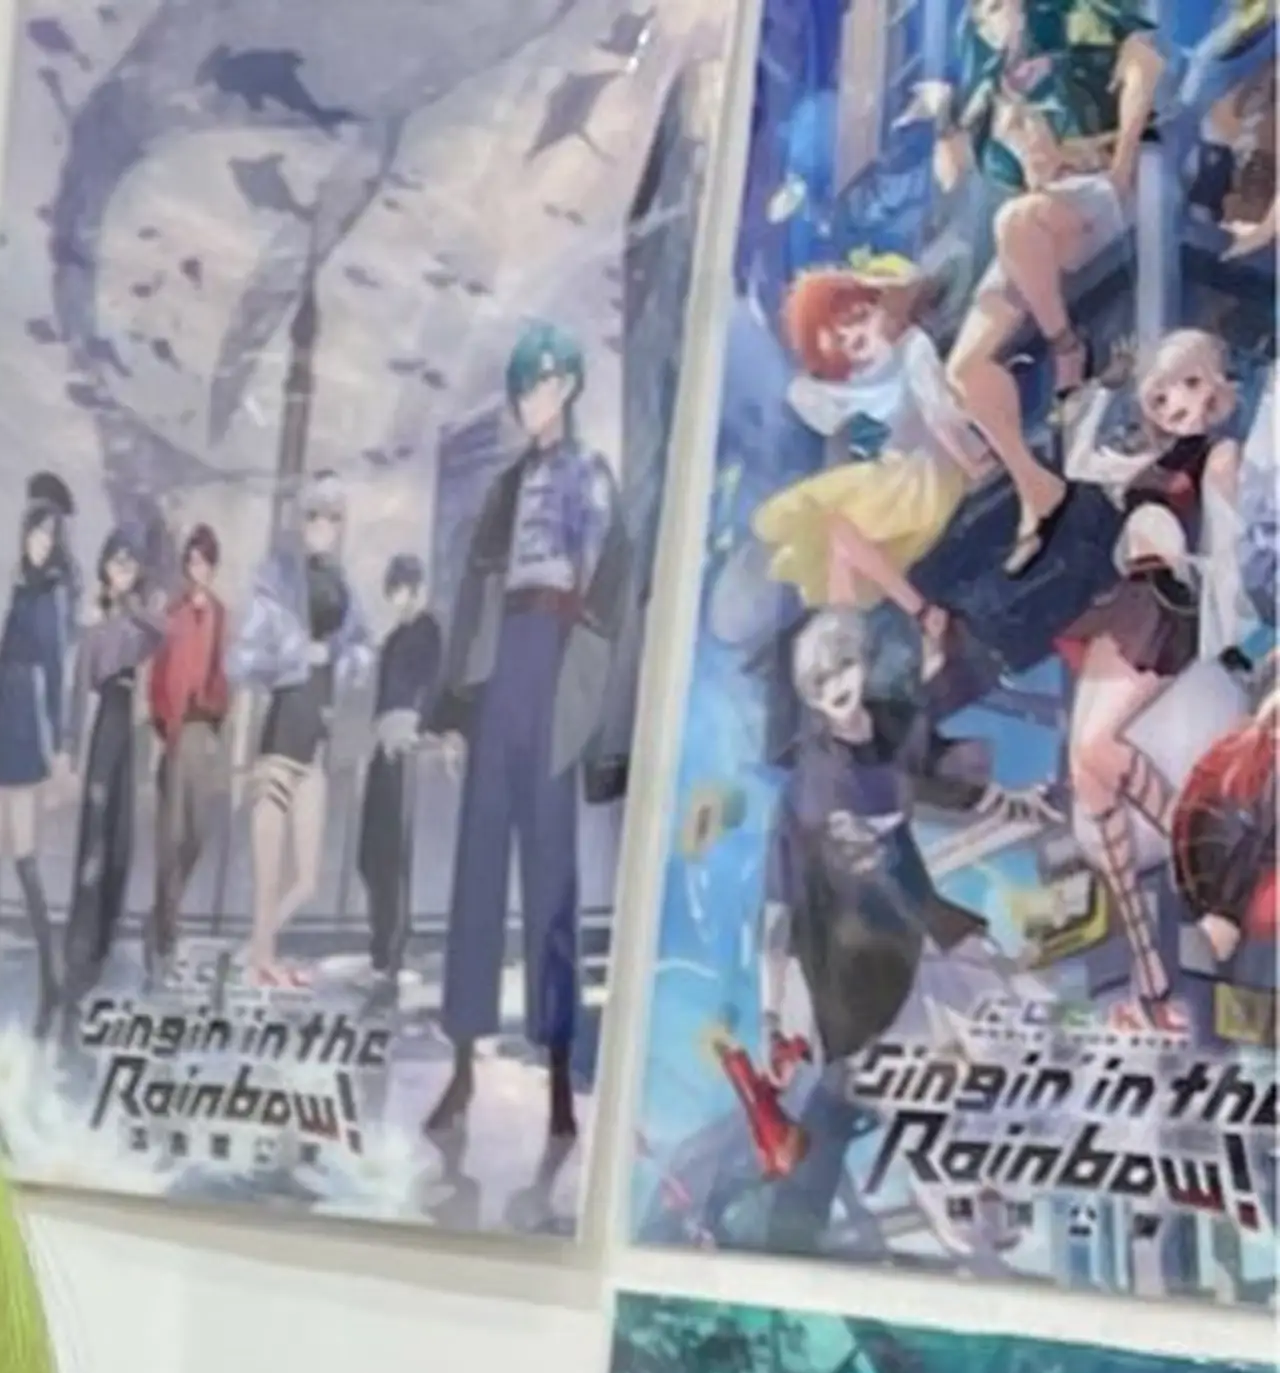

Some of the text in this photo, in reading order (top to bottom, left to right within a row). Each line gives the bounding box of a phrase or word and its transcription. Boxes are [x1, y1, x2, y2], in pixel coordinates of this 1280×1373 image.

[241, 1006, 290, 1061] in
[296, 1012, 391, 1066] the
[89, 1055, 363, 1155] Rainbow!
[1088, 1057, 1156, 1117] in
[861, 1109, 1262, 1232] Rainbow!
